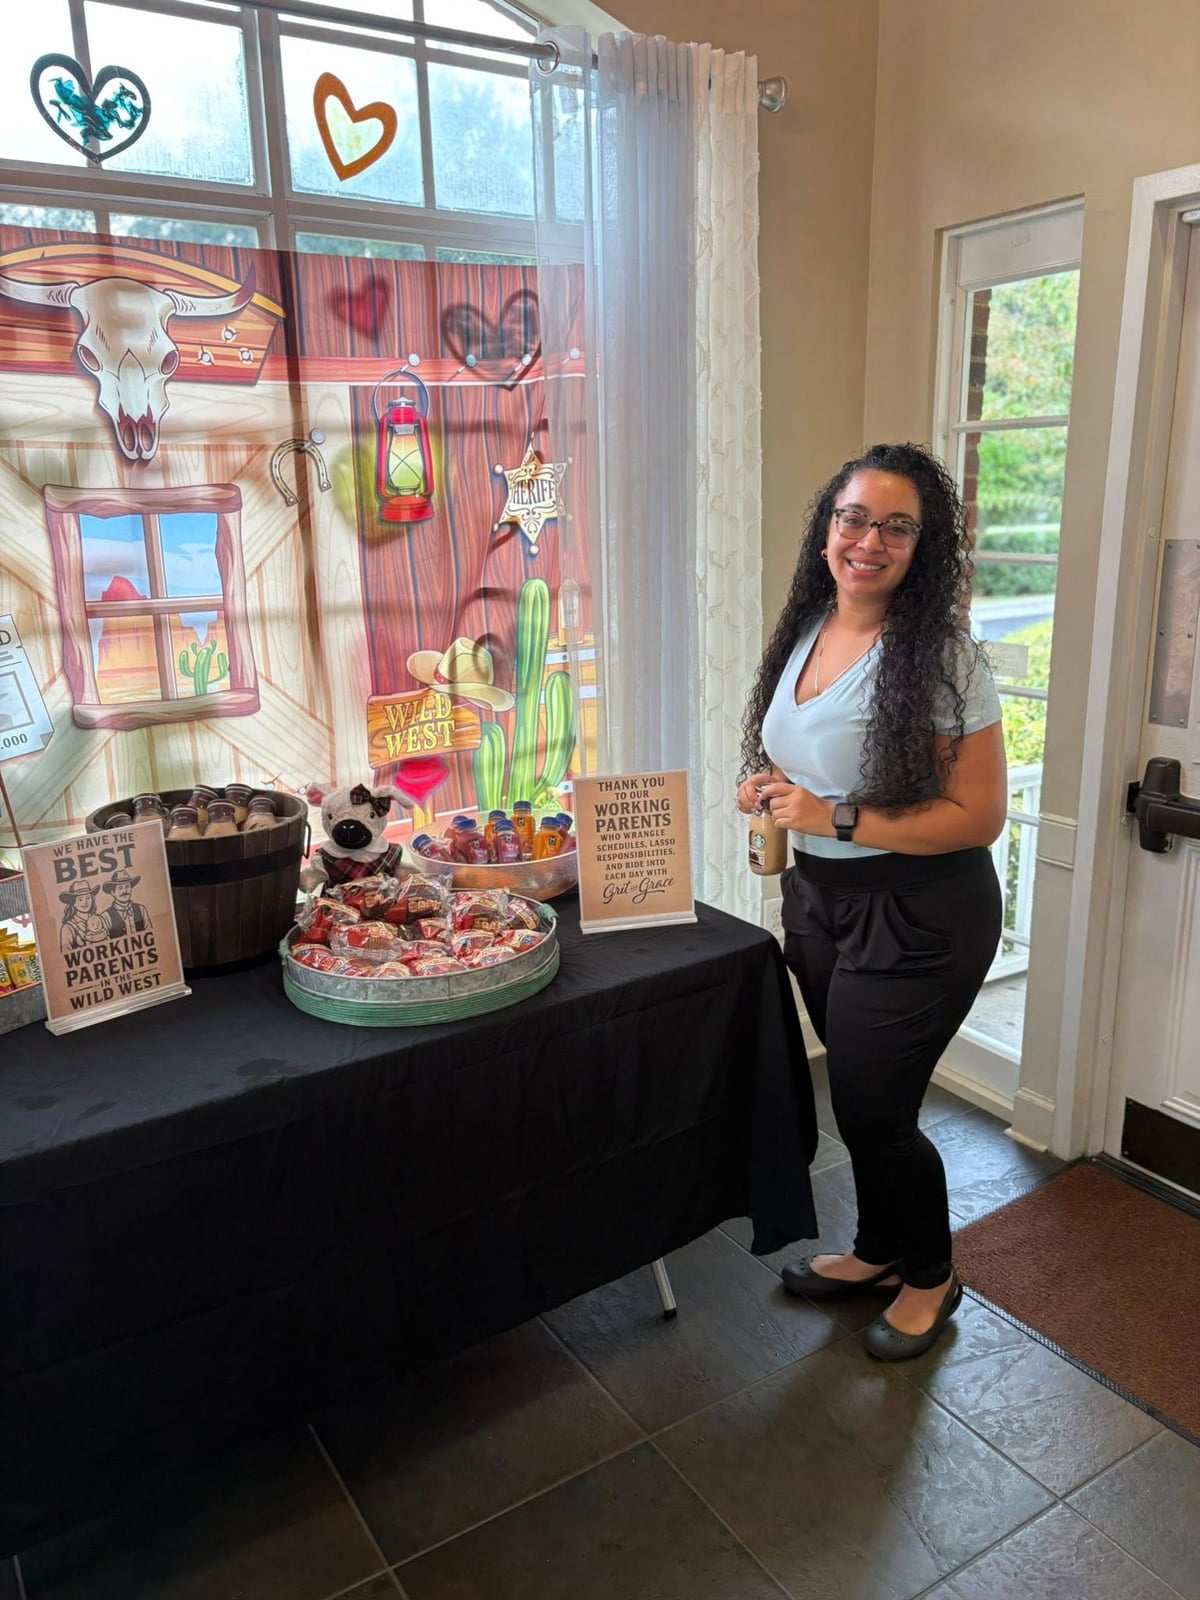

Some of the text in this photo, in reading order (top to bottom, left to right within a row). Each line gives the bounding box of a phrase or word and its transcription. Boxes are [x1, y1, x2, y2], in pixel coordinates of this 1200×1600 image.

[384, 692, 452, 732] WILD
[384, 719, 455, 759] WEST
[597, 777, 665, 792] THANK YOU
[615, 790, 649, 800] TO OUR
[594, 798, 670, 817] WORKING
[596, 813, 671, 833] PARENTS
[53, 832, 135, 857] WE HAVE THE
[596, 838, 676, 852] SCHEDULES, LASSO
[600, 829, 665, 842] WHO WRANGLE
[53, 844, 136, 884] BEST
[596, 848, 676, 862] RESPONSIBILITIES,
[605, 858, 666, 871] AND RIDE INTO
[605, 868, 667, 881] EACH DAY WITH
[602, 877, 675, 905] Grit Grace
[63, 932, 155, 968] WORKING
[65, 948, 158, 988] PARENTS
[100, 972, 132, 988] IN THE
[70, 973, 162, 1010] WILD WEST
